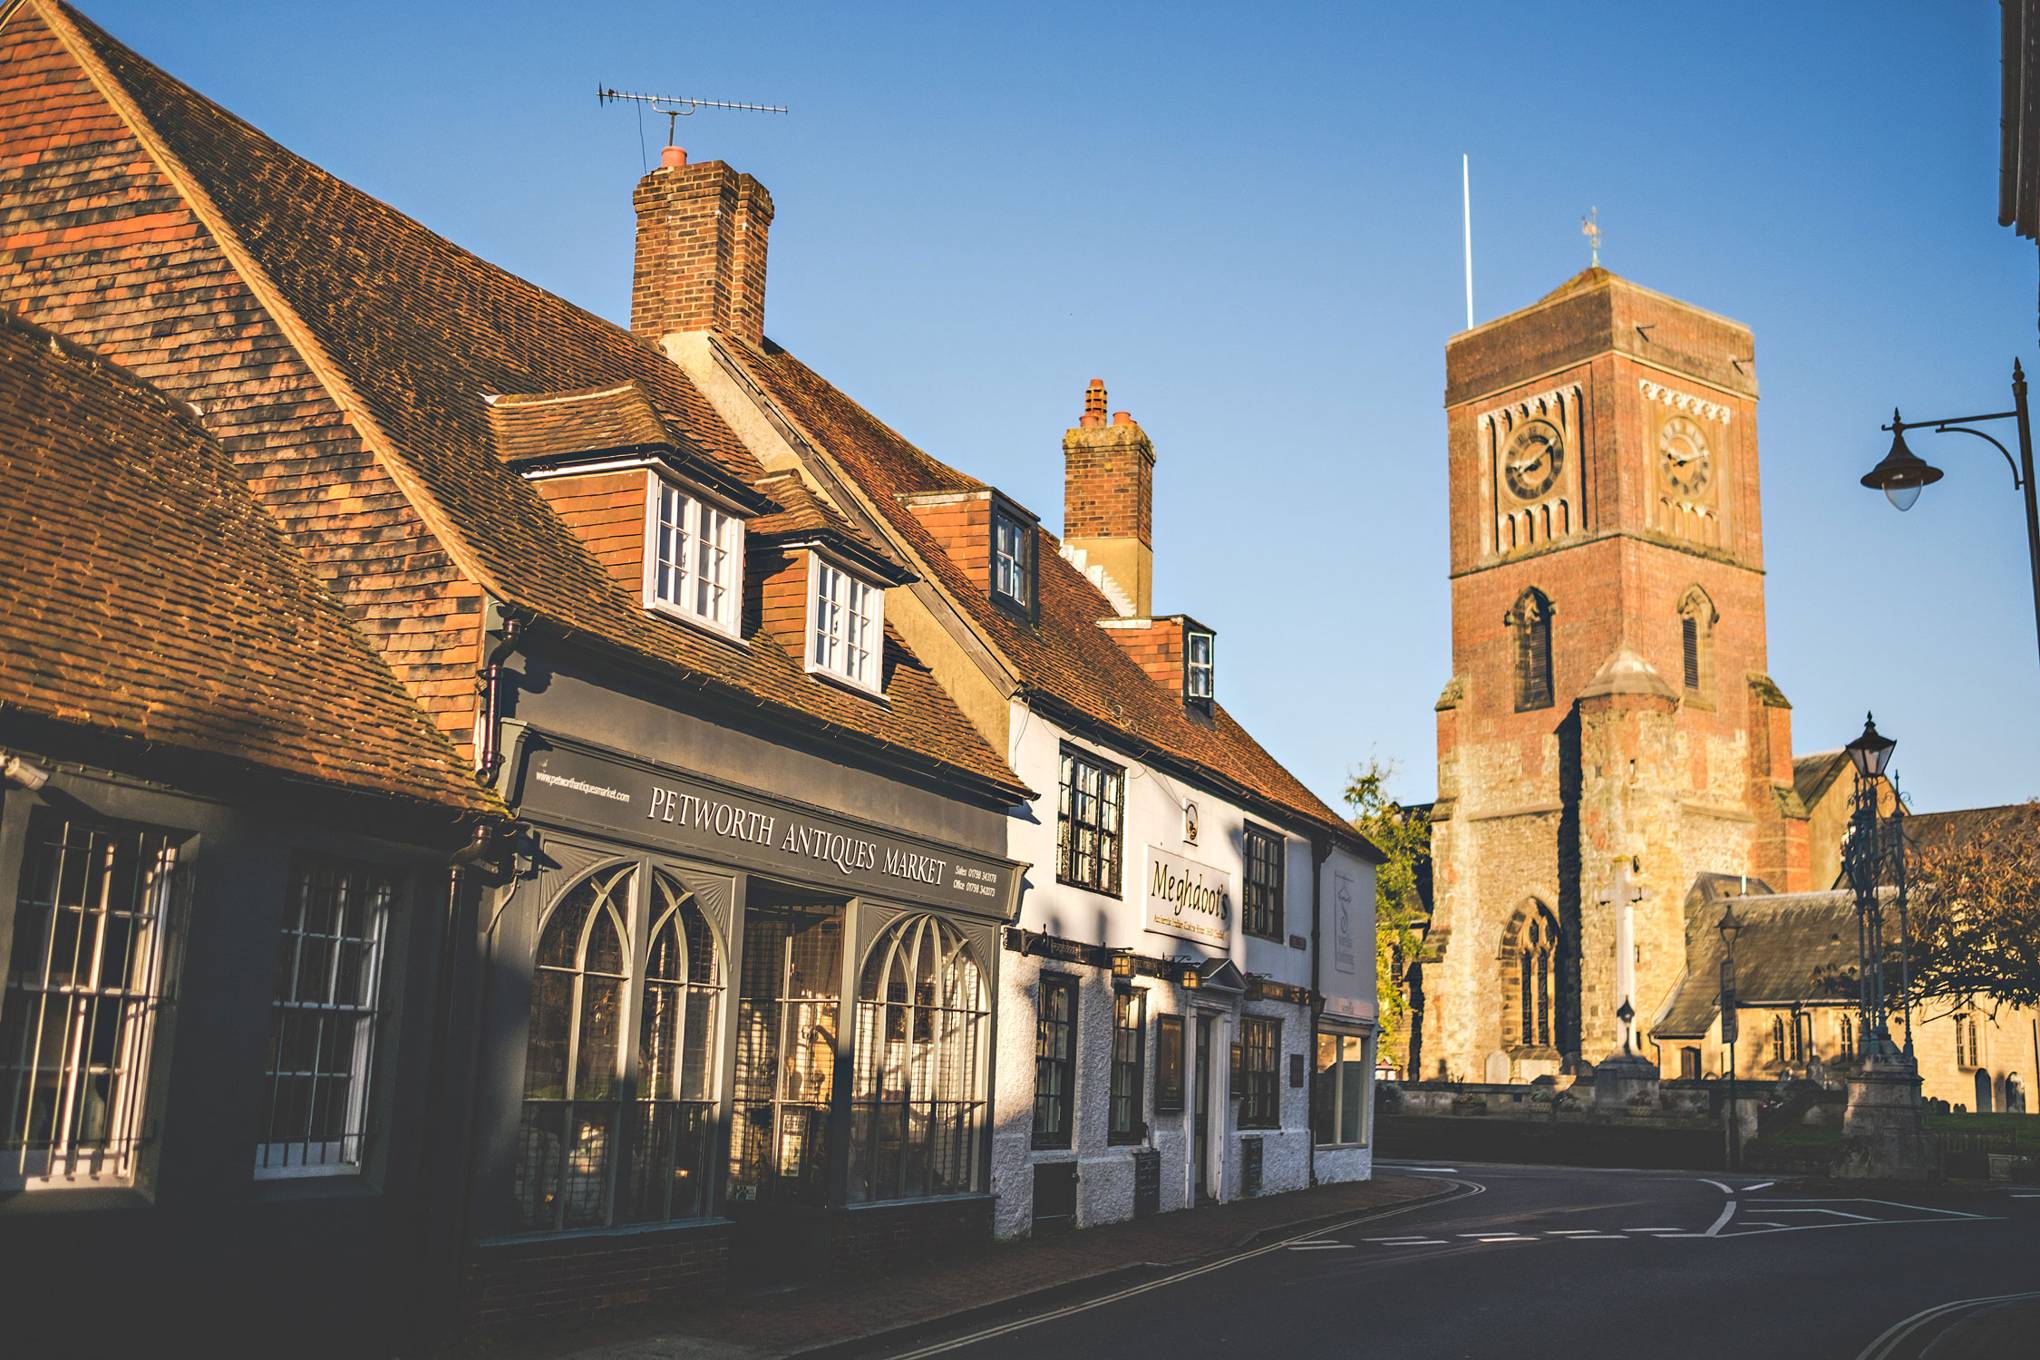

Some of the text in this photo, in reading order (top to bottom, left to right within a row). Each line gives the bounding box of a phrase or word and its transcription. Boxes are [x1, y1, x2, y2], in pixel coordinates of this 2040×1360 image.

[536, 771, 630, 802] www.petworthantiquesmarket.com
[647, 786, 947, 886] PETWORTH ANTIQUES MARKET
[953, 879, 965, 890] Office
[1151, 860, 1228, 920] Meghdoot's
